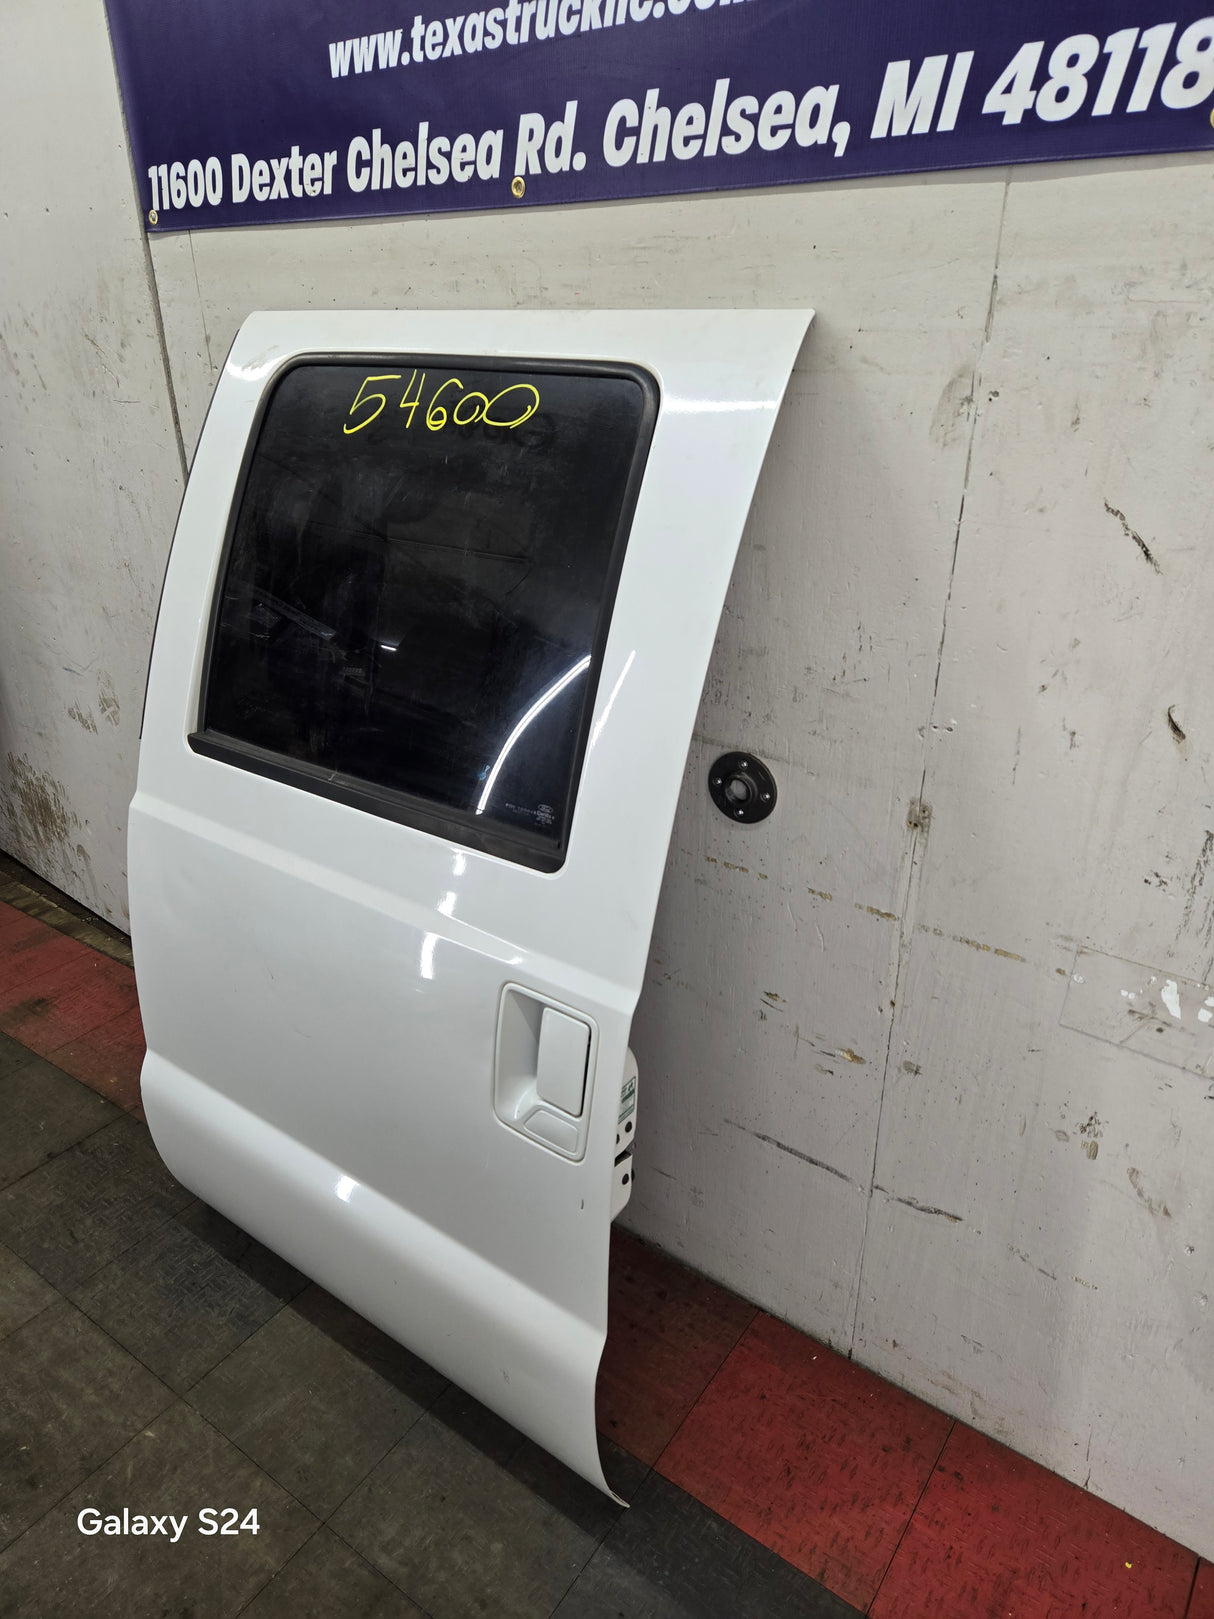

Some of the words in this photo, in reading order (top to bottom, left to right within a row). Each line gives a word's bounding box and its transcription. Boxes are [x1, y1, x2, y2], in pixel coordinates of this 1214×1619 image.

[148, 157, 223, 211] 11600
[231, 146, 338, 204] Dexter
[346, 121, 504, 193] Chelsea
[514, 100, 587, 177] Rd.
[603, 78, 851, 168] Chelsea,
[870, 51, 975, 139] MI
[982, 16, 1214, 126] 48118
[343, 369, 541, 434] 54600
